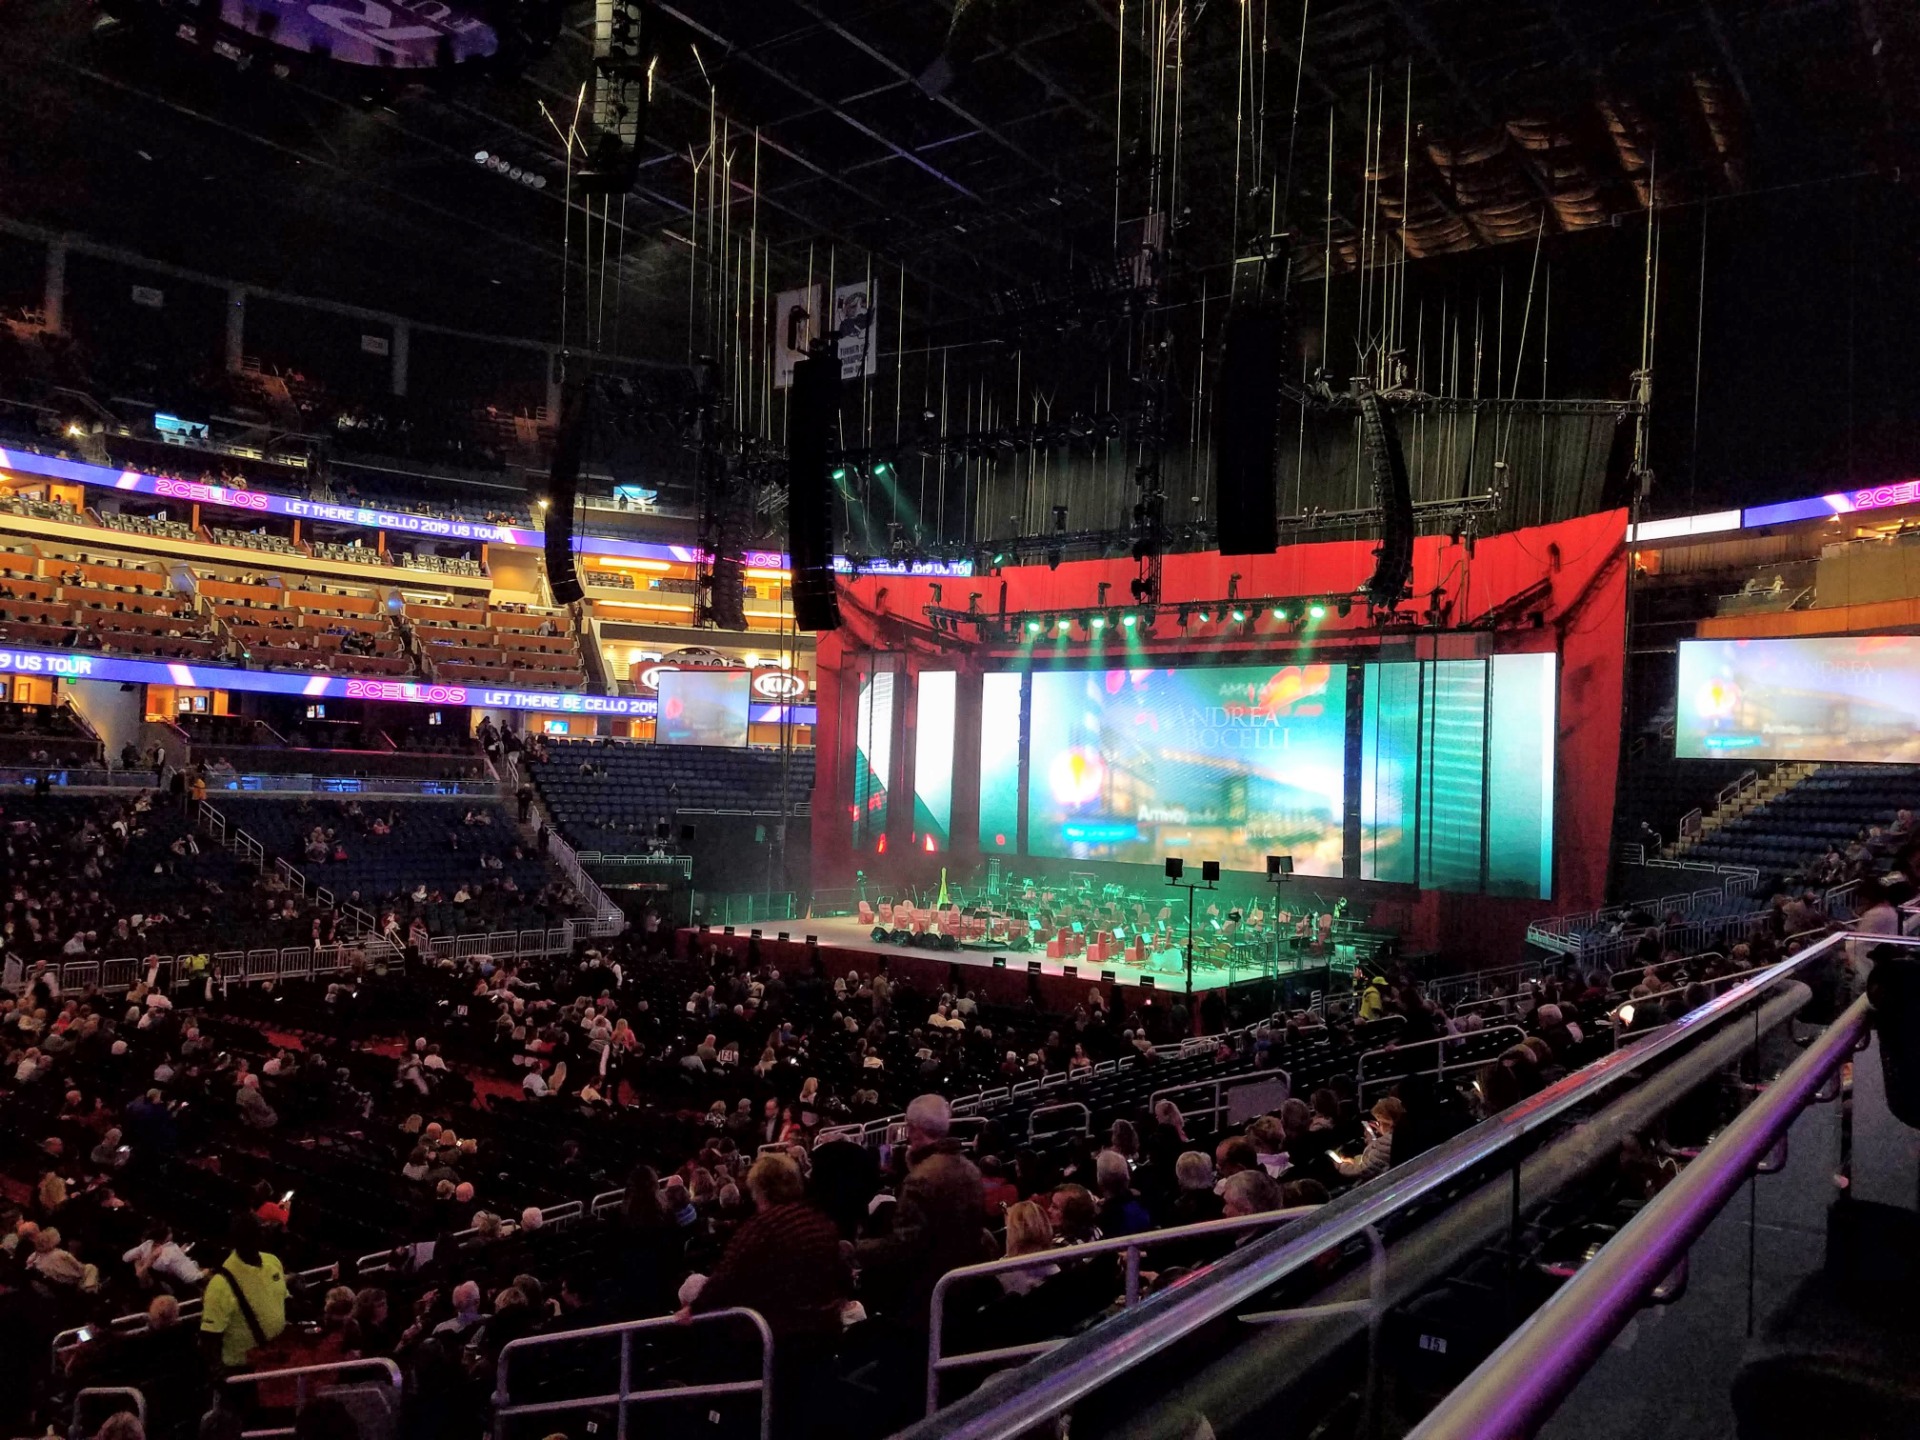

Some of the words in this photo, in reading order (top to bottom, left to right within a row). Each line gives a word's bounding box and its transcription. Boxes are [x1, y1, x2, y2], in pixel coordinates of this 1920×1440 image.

[156, 480, 268, 510] 2CELLOS
[285, 501, 310, 514] LET
[312, 504, 354, 521] THERE
[358, 512, 376, 523] BE
[378, 515, 418, 530] CELLO
[420, 519, 450, 534] 2019
[452, 524, 470, 537] US
[15, 655, 43, 671] US
[45, 657, 91, 675] TOUR
[347, 681, 466, 704] 2CELLOS
[485, 692, 511, 705] LET
[514, 694, 559, 709] THERE
[562, 697, 581, 710] BE
[585, 699, 628, 713] CELLO
